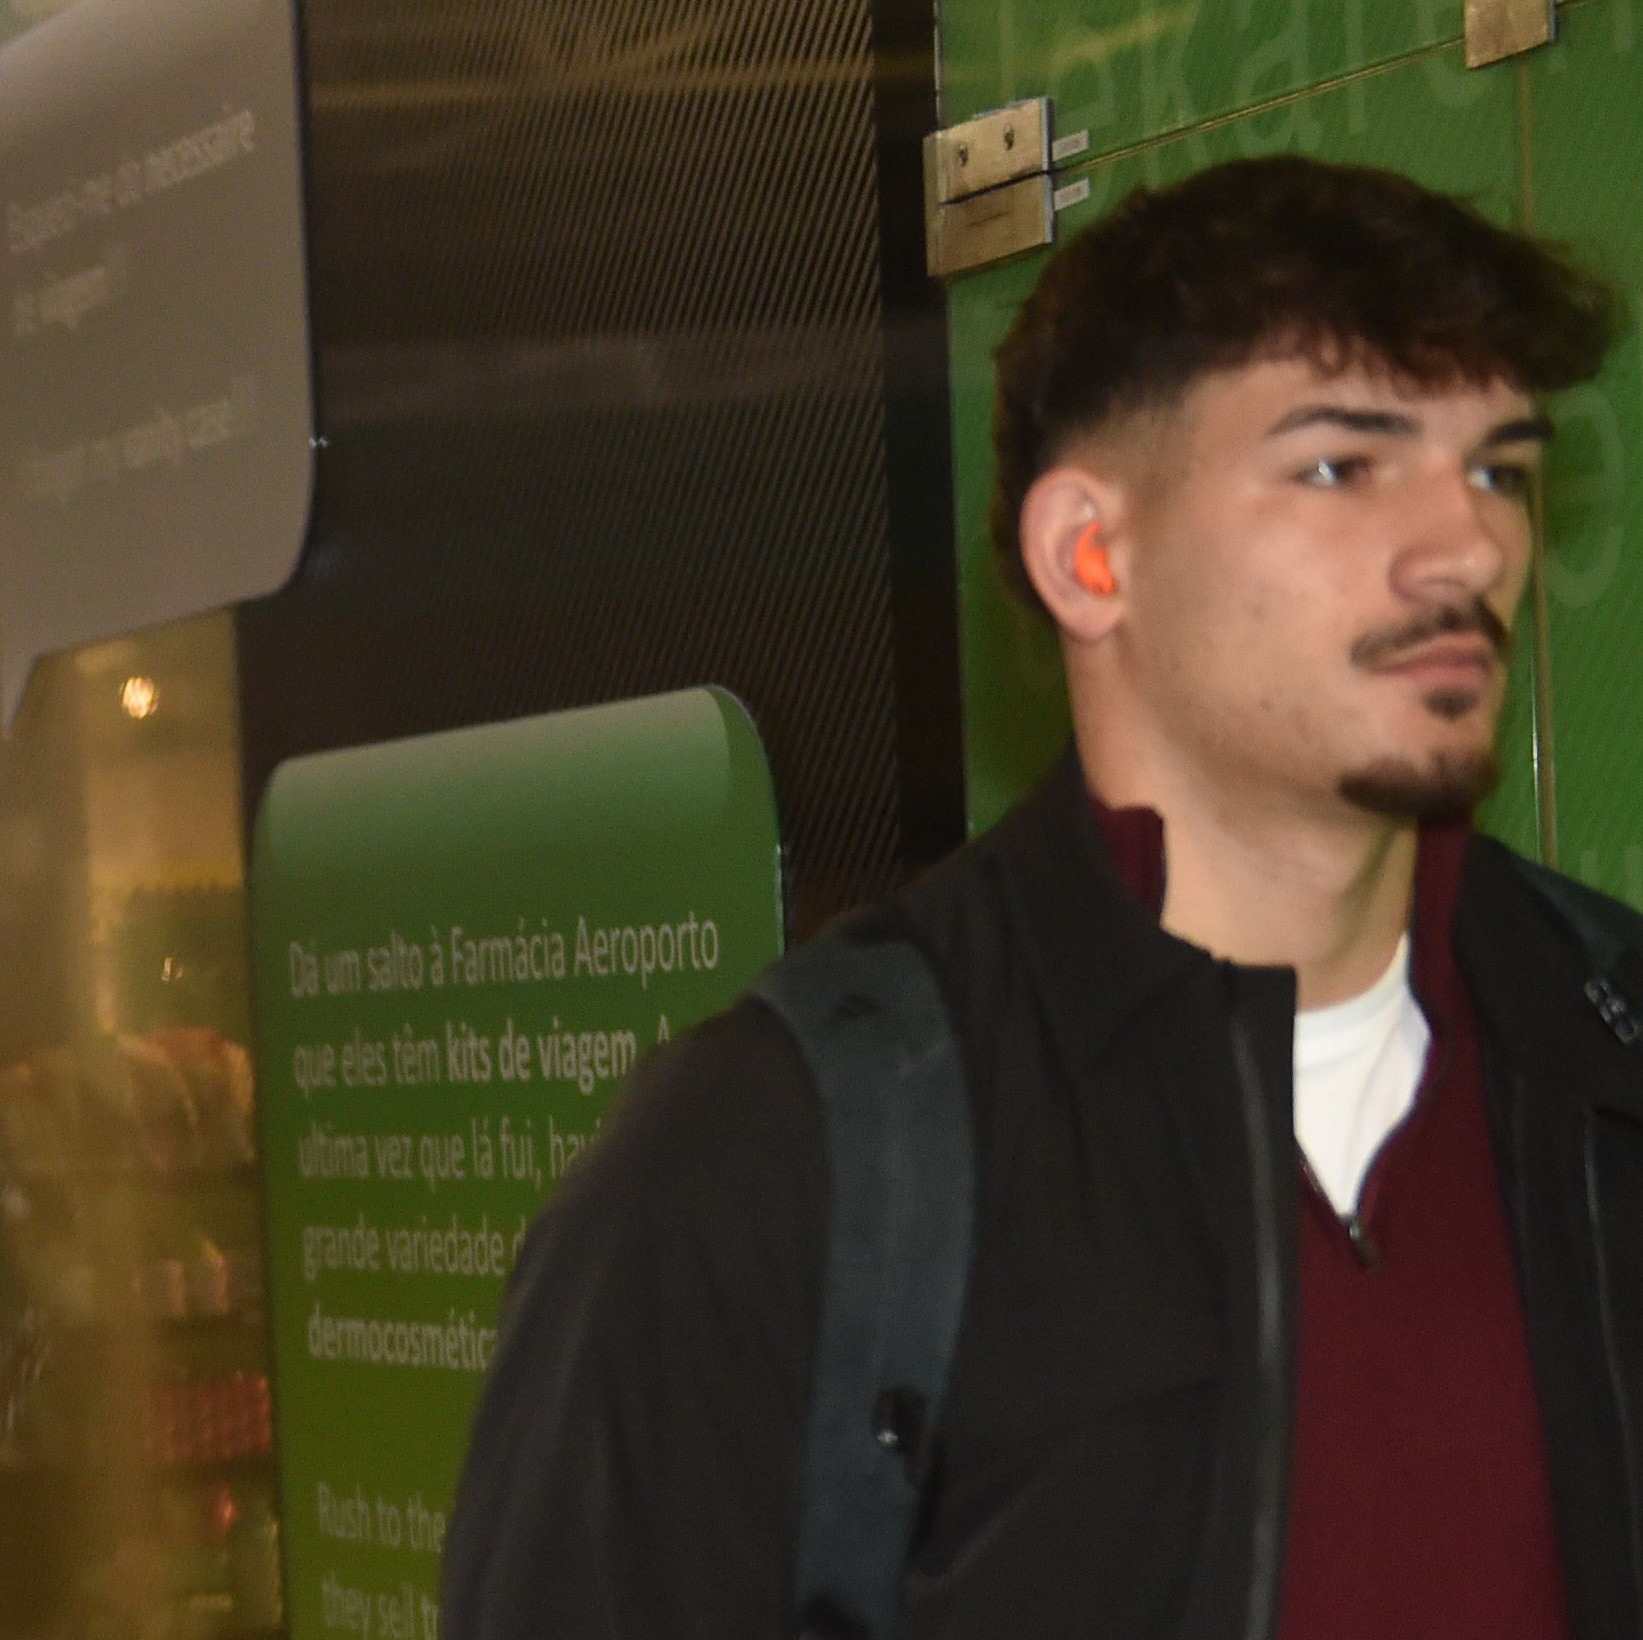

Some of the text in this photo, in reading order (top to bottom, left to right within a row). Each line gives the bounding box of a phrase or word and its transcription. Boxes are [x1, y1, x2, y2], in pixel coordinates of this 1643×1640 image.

[289, 911, 720, 998] Dá um salto à Farmácia Aeroporto
[294, 1043, 337, 1099] que
[341, 1026, 386, 1086] eles
[393, 1022, 440, 1085] têm
[446, 1018, 492, 1083] kits
[498, 1016, 532, 1081] de
[375, 1134, 414, 1180] vez
[419, 1134, 465, 1194] que
[471, 1115, 494, 1181] lá
[500, 1113, 543, 1191] fui,
[303, 1210, 380, 1282] grande
[386, 1212, 505, 1277] variedade
[317, 1478, 446, 1554] Rush to the
[378, 1581, 415, 1640] sell
